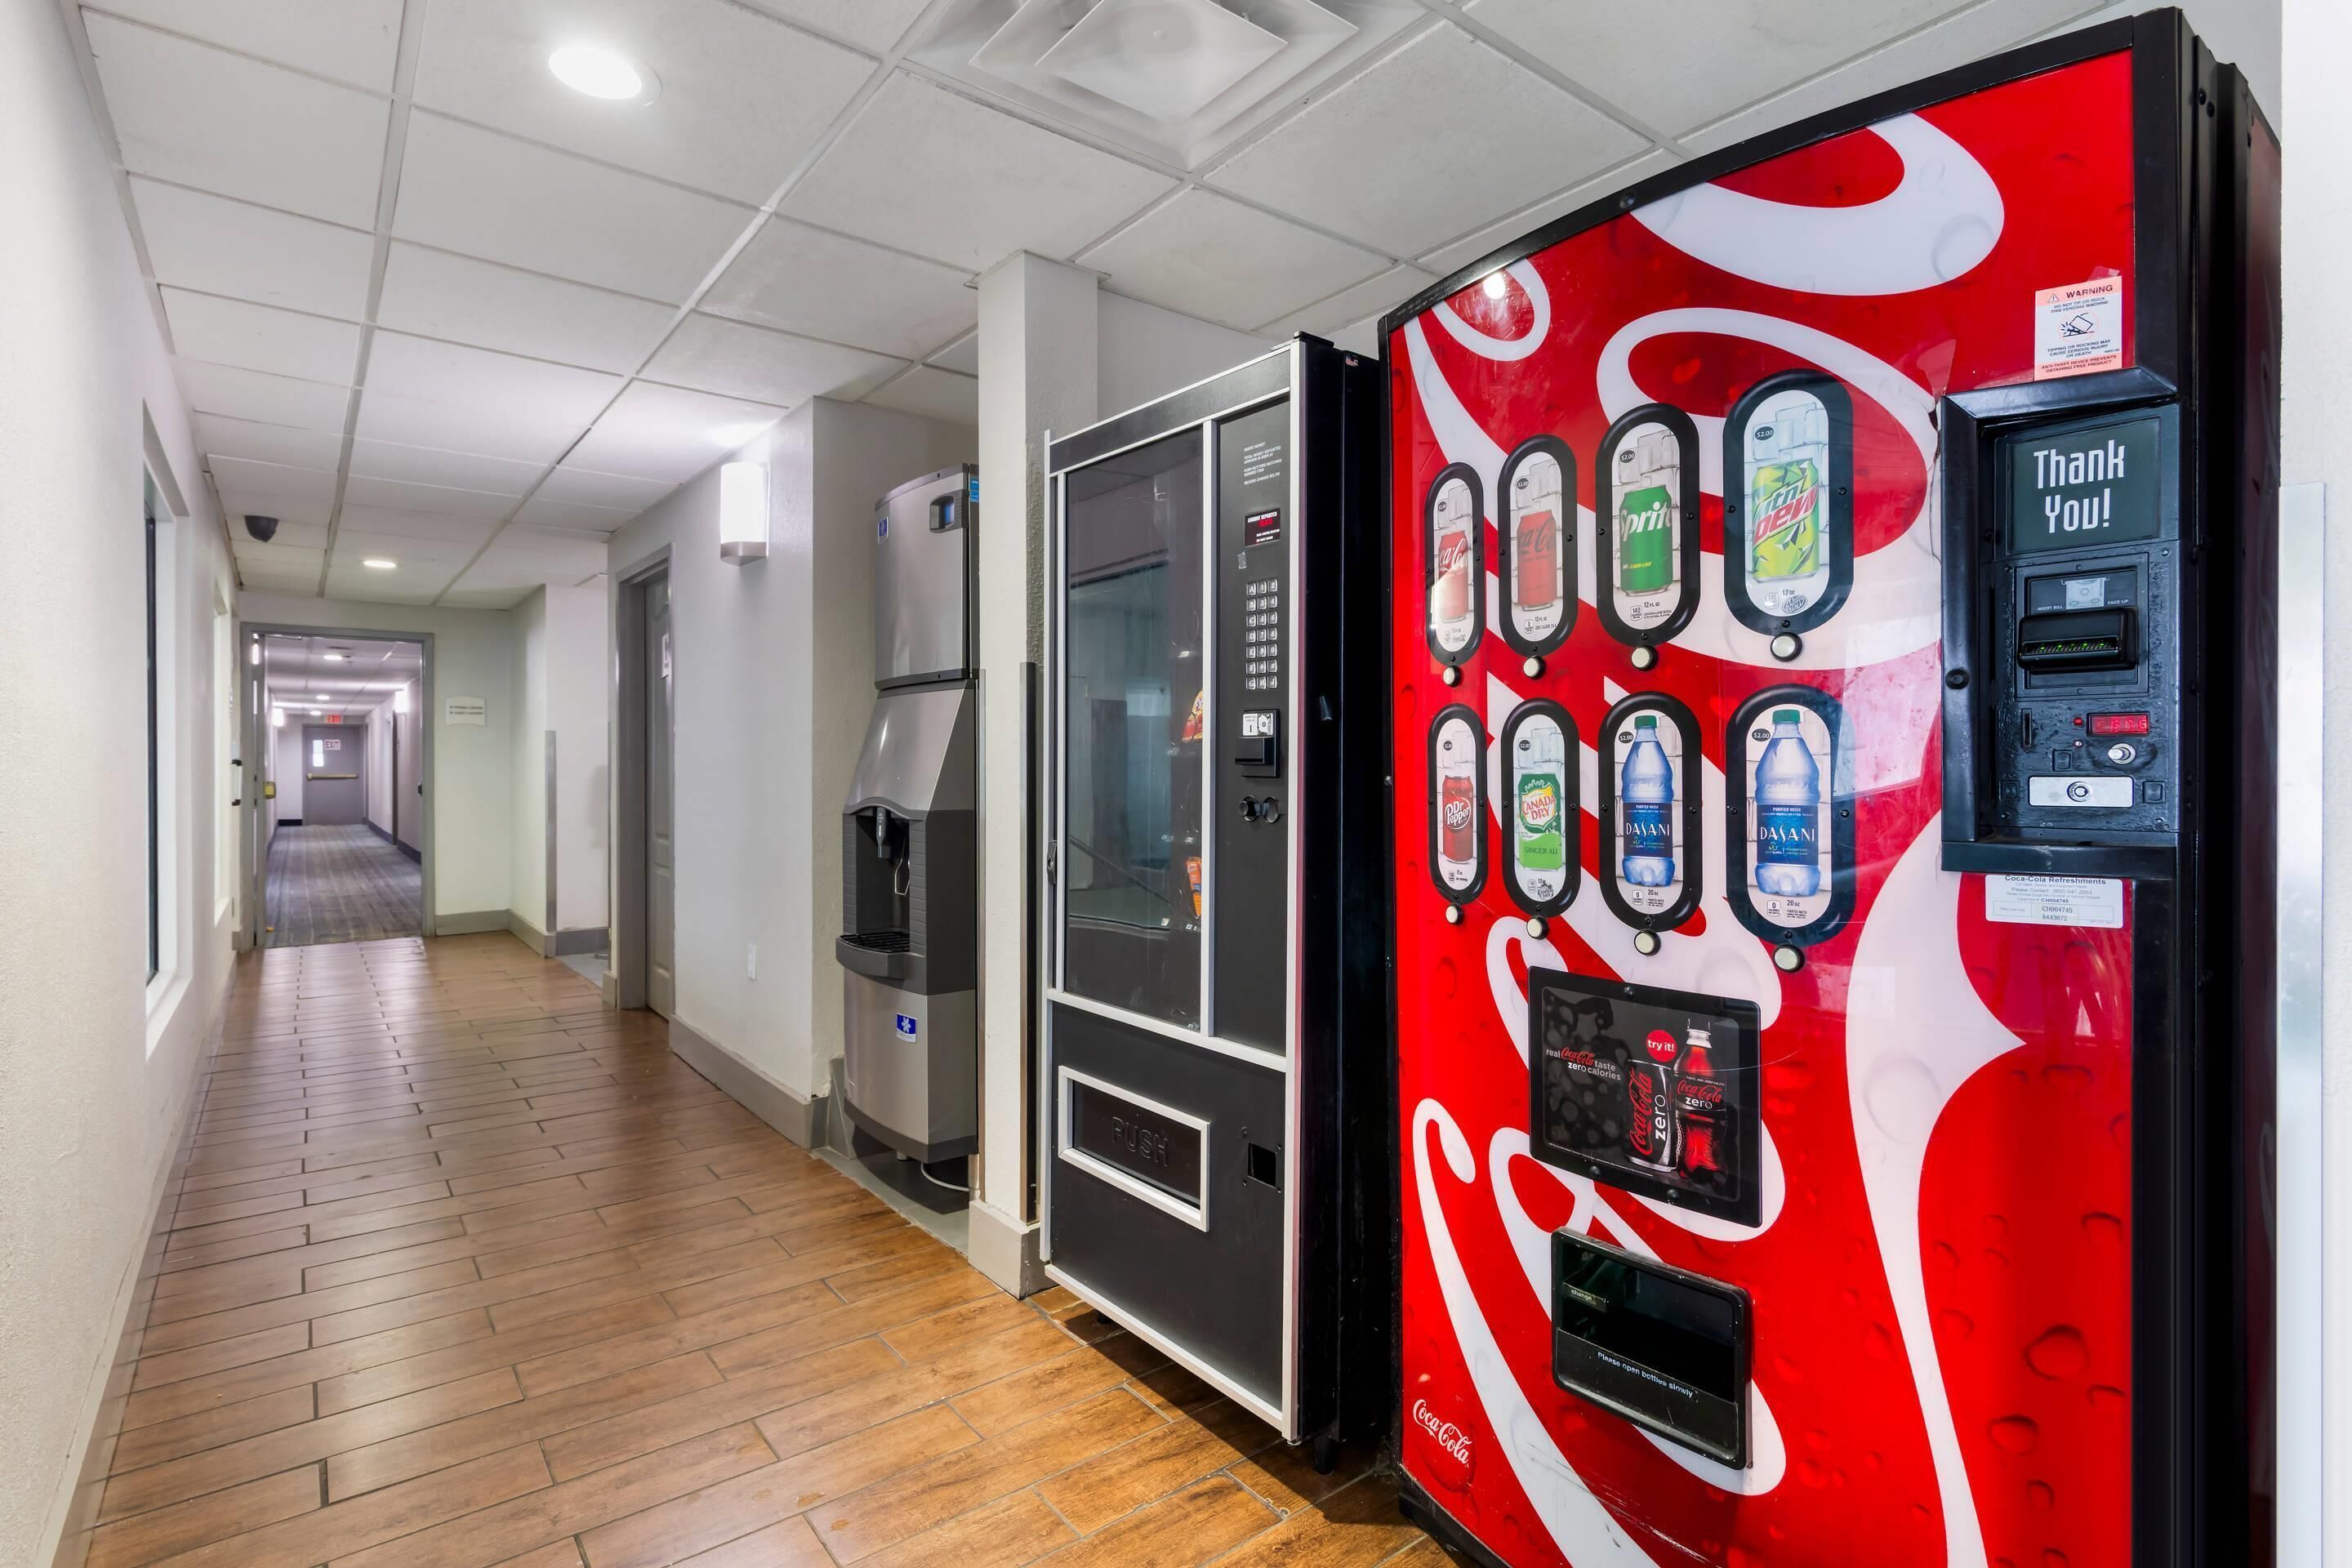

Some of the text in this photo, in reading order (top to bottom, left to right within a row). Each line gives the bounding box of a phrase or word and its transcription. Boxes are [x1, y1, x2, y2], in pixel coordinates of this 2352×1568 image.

[2066, 285, 2113, 299] WARNING
[2046, 365, 2073, 373] OBTAINING
[1757, 429, 1774, 438] $2.00
[2034, 439, 2125, 488] Thank
[2045, 488, 2110, 533] You!
[1453, 800, 1463, 813] Dr
[1521, 795, 1556, 816] CANADA
[1531, 807, 1551, 821] DRY
[1447, 804, 1470, 826] Pepper
[1626, 820, 1670, 838] DASANI
[1760, 823, 1815, 844] DASANI
[1524, 846, 1548, 855] GINGER
[2005, 875, 2047, 883] Coca-Cola
[2048, 876, 2107, 885] Refreshments
[1647, 1039, 1674, 1053] try it!
[1546, 1049, 1561, 1058] real
[1594, 1059, 1616, 1071] taste
[1568, 1062, 1621, 1080] zero calories
[1685, 1097, 1713, 1110] zero
[1655, 1094, 1666, 1142] zero
[1111, 1116, 1169, 1167] PUSH
[1570, 1290, 1592, 1301] change
[1597, 1352, 1693, 1398] Please open bottles slowly
[1413, 1399, 1472, 1464] Coca-Cola
